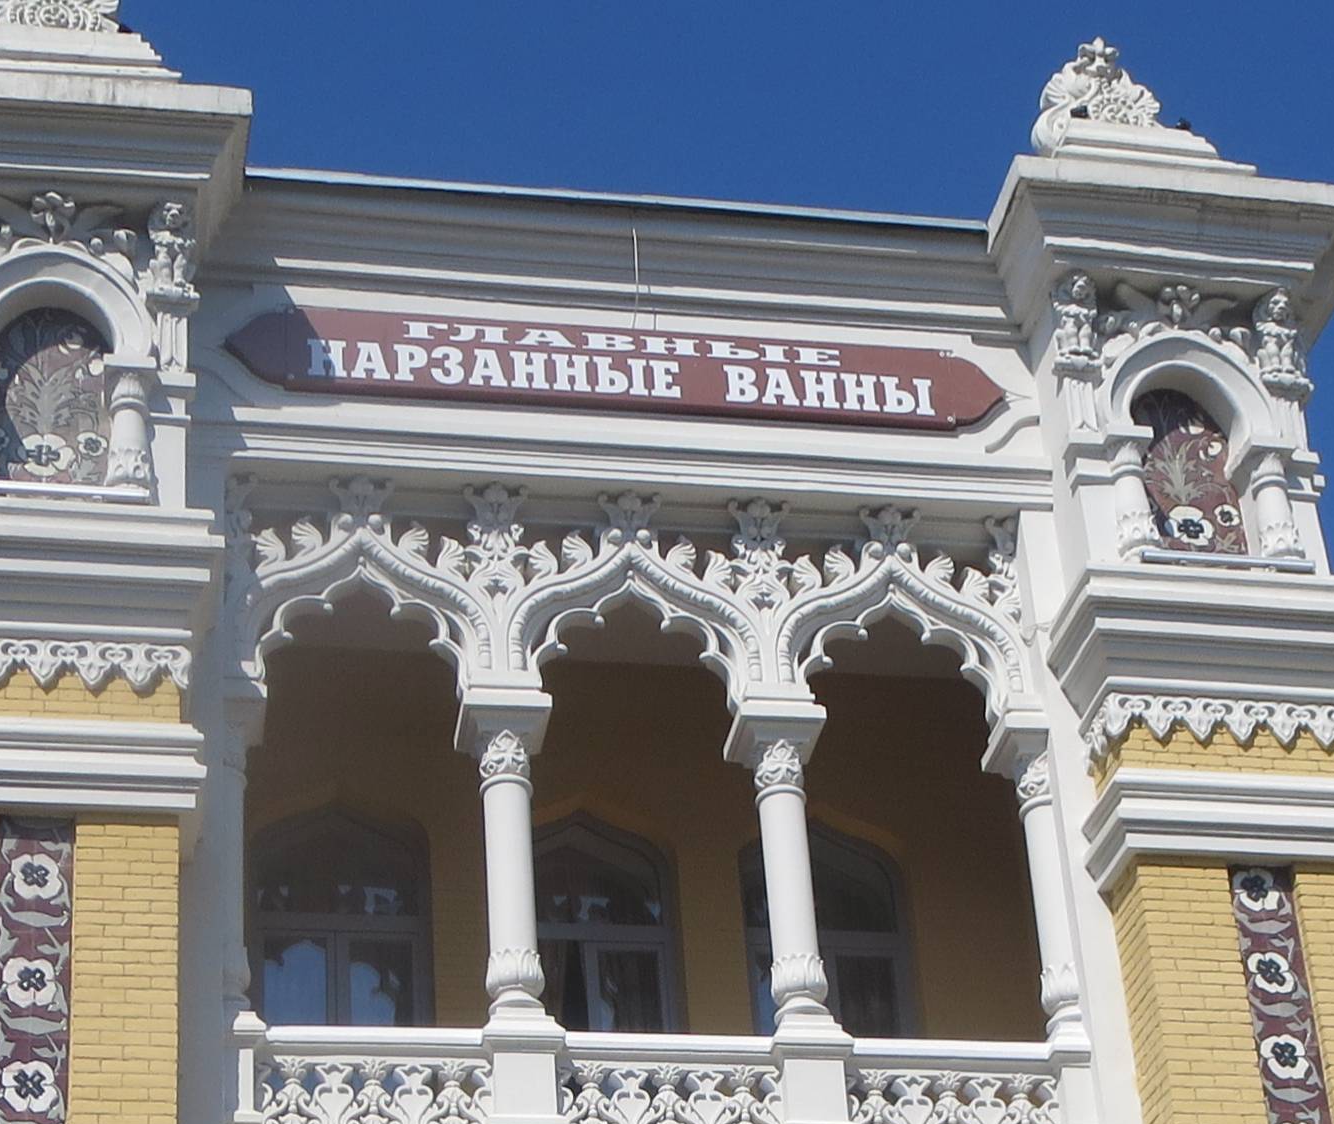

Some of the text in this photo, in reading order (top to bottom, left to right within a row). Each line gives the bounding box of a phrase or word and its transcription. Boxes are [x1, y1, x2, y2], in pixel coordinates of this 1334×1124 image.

[403, 320, 841, 367] ГЛАВНЫЕ
[306, 338, 936, 416] НАРЗАННЫЕ ВАННЫ
